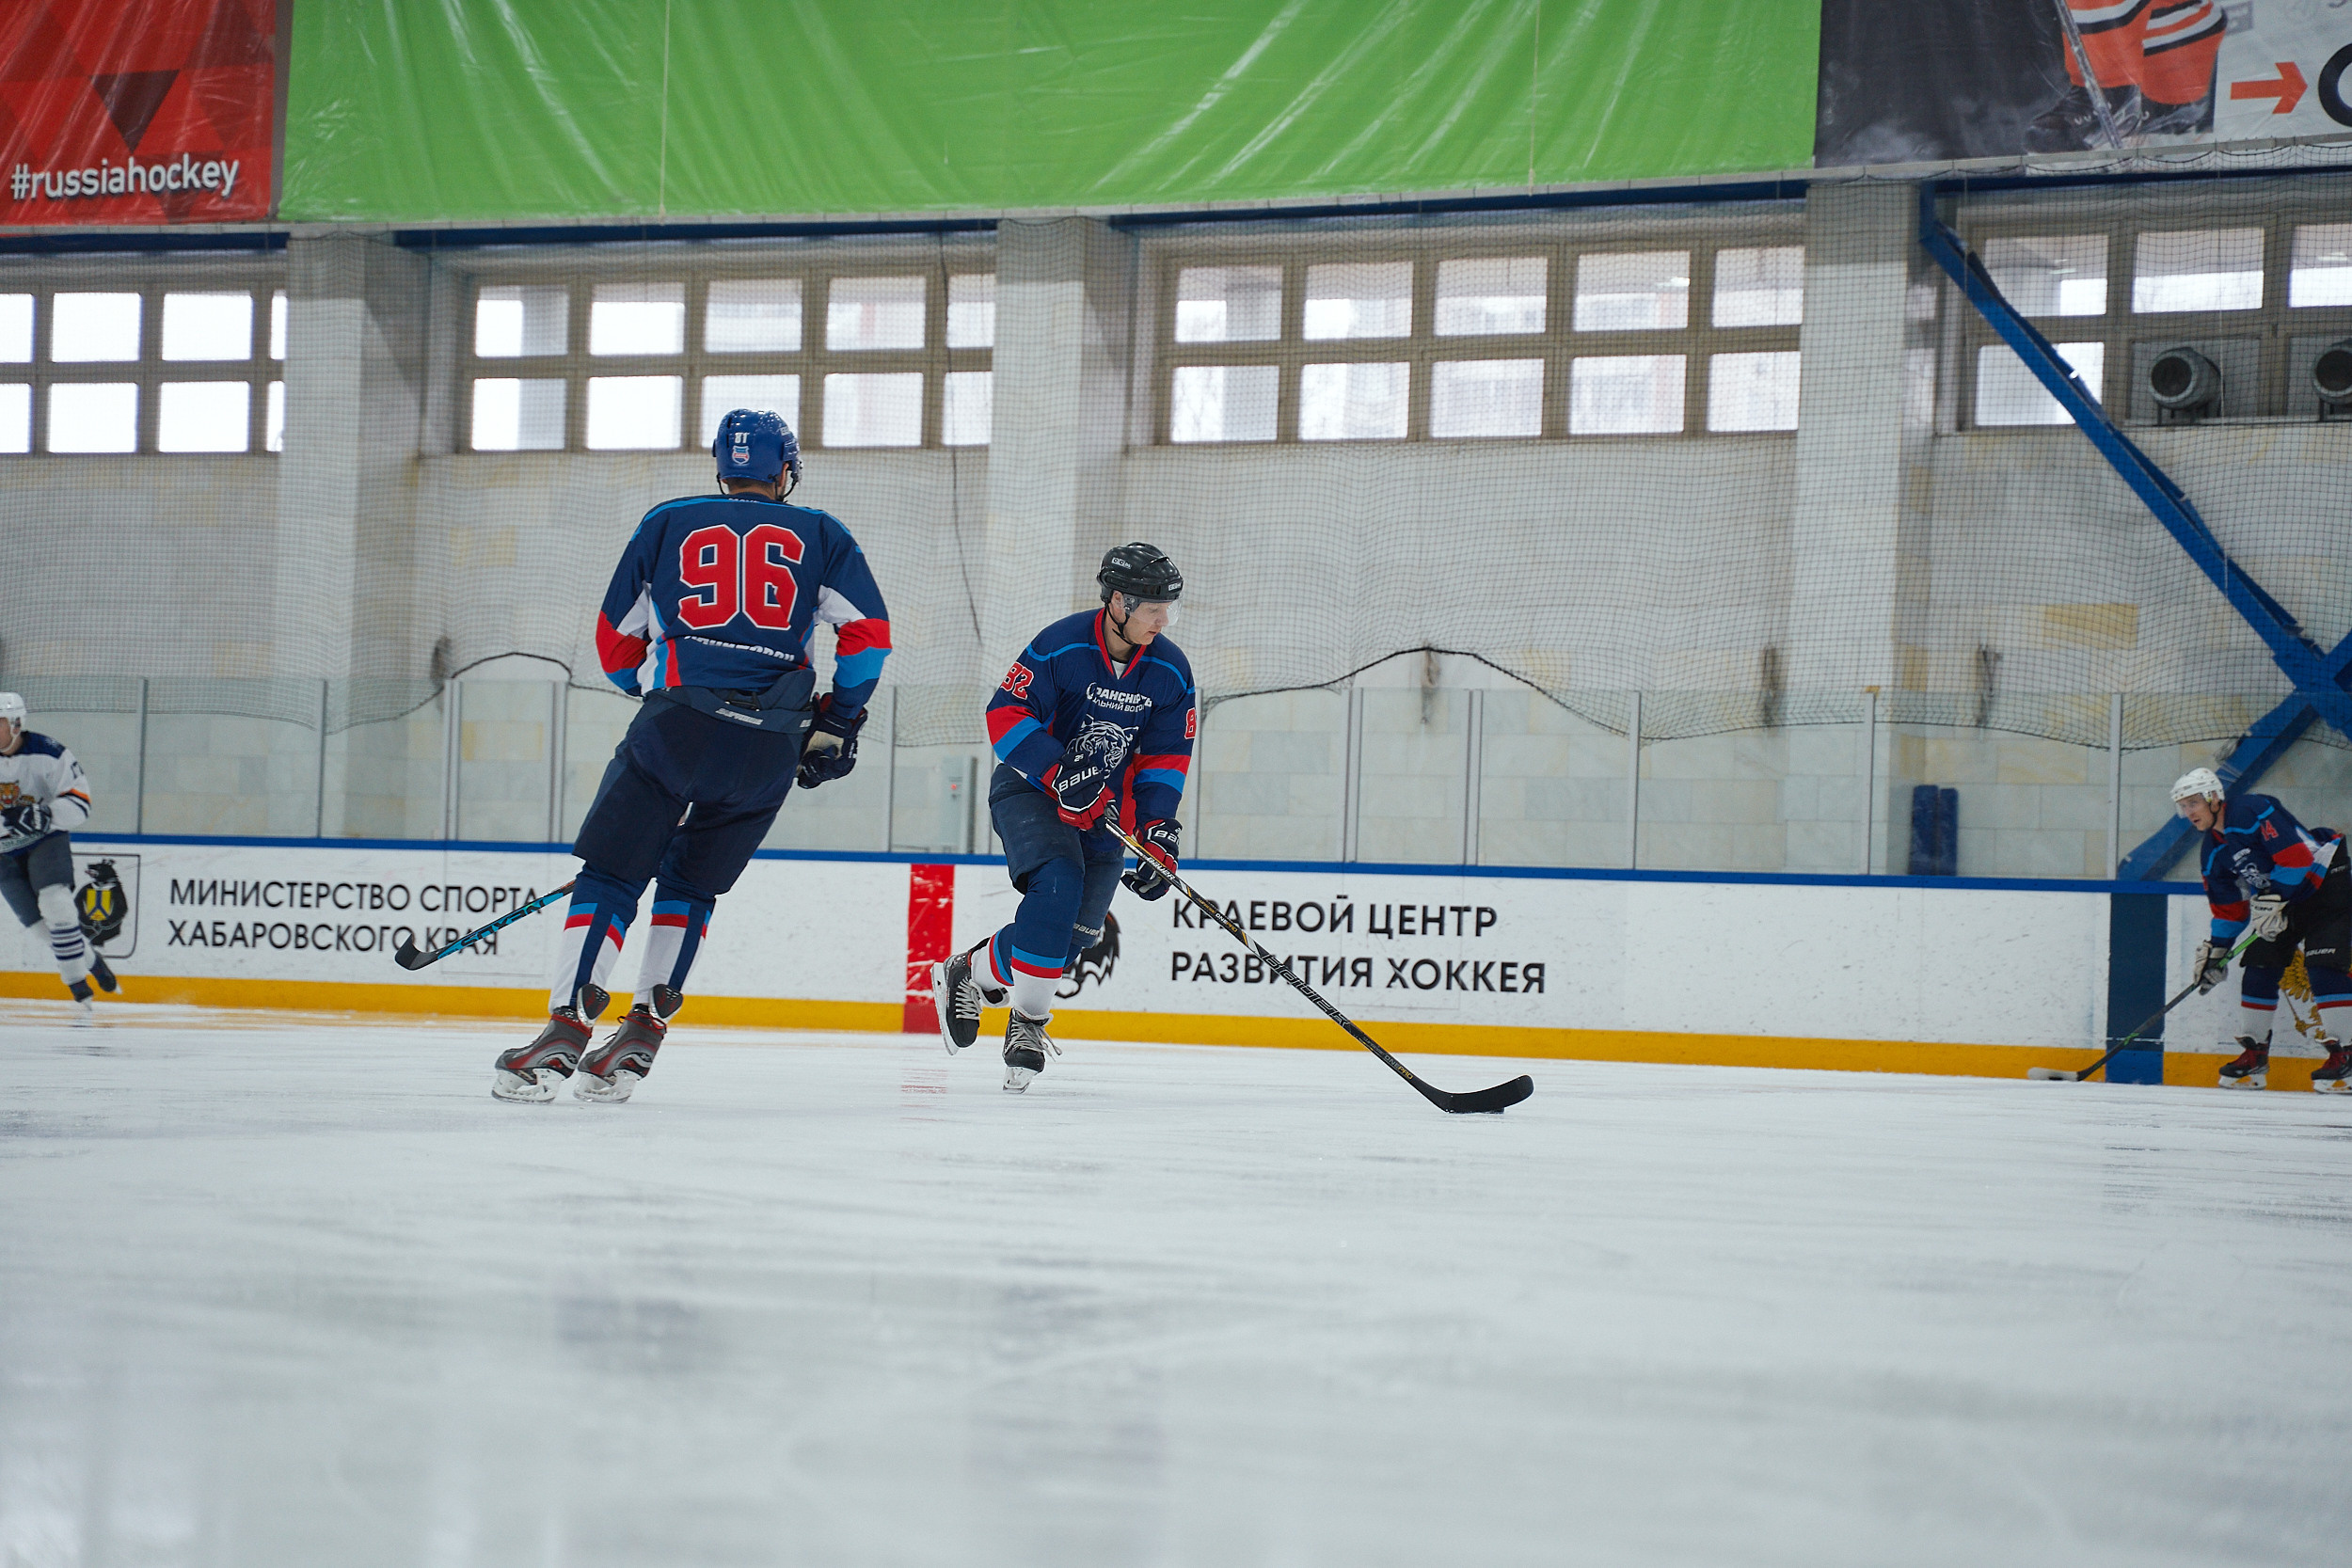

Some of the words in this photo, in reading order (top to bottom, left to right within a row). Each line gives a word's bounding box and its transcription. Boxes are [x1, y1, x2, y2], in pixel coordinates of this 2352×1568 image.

[10, 152, 239, 199] #russiahockey
[677, 524, 805, 630] 96
[1000, 661, 1034, 700] 82
[170, 879, 410, 911] МИНИСТЕРСТВО
[420, 885, 542, 914] СПОРТА
[1173, 895, 1354, 934] КРАЕВОЙ
[1369, 903, 1497, 940] ЦЕНТР
[167, 920, 416, 953] ХАБАРОВСКОГО
[1171, 951, 1373, 989] РАЗВИТИЯ
[1386, 958, 1545, 994] ХОККЕЯ
